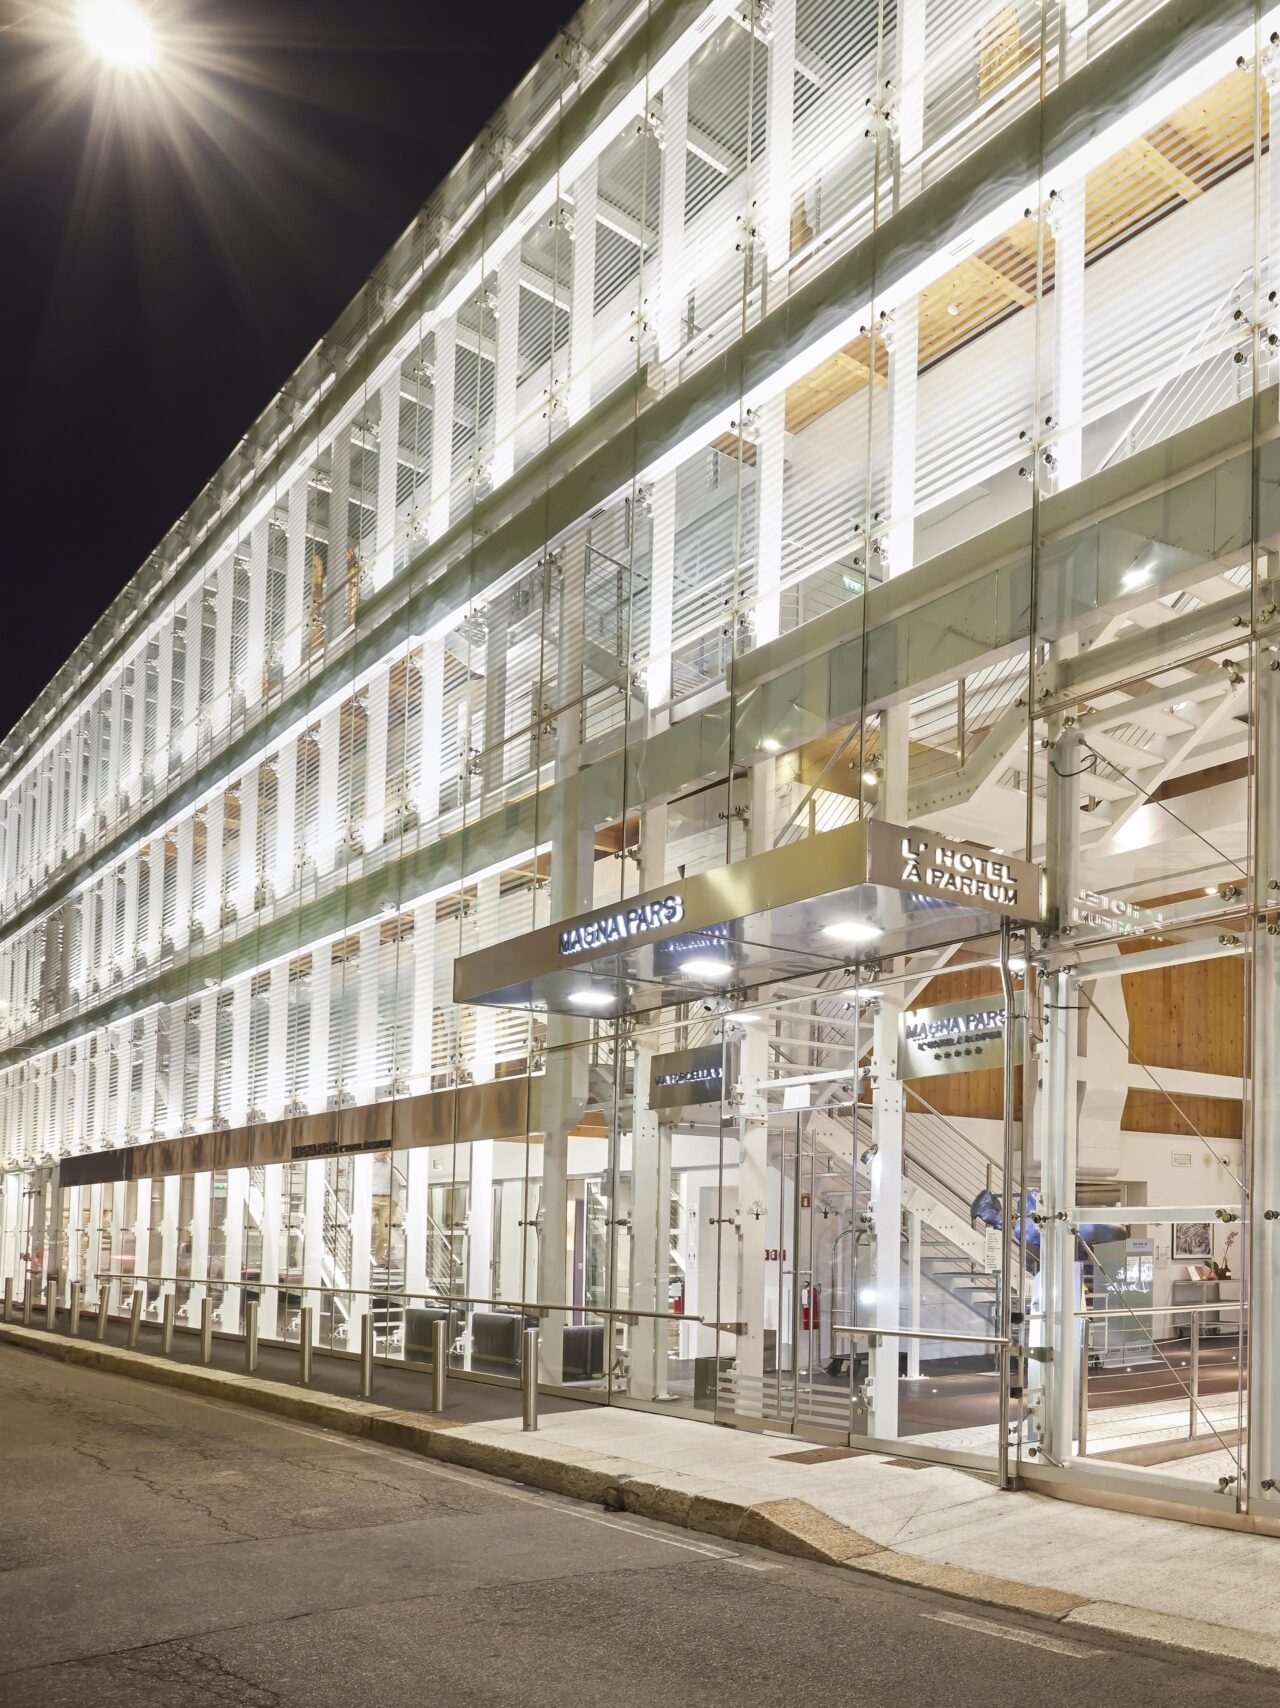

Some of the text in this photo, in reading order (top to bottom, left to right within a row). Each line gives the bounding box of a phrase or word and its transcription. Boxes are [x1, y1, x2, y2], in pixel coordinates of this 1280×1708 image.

[901, 838, 1018, 884] L' HOTEL
[901, 858, 1018, 906] À PARFUM
[559, 914, 624, 955] MAGNA
[626, 895, 686, 935] PARS
[906, 1017, 961, 1041] MAGNA
